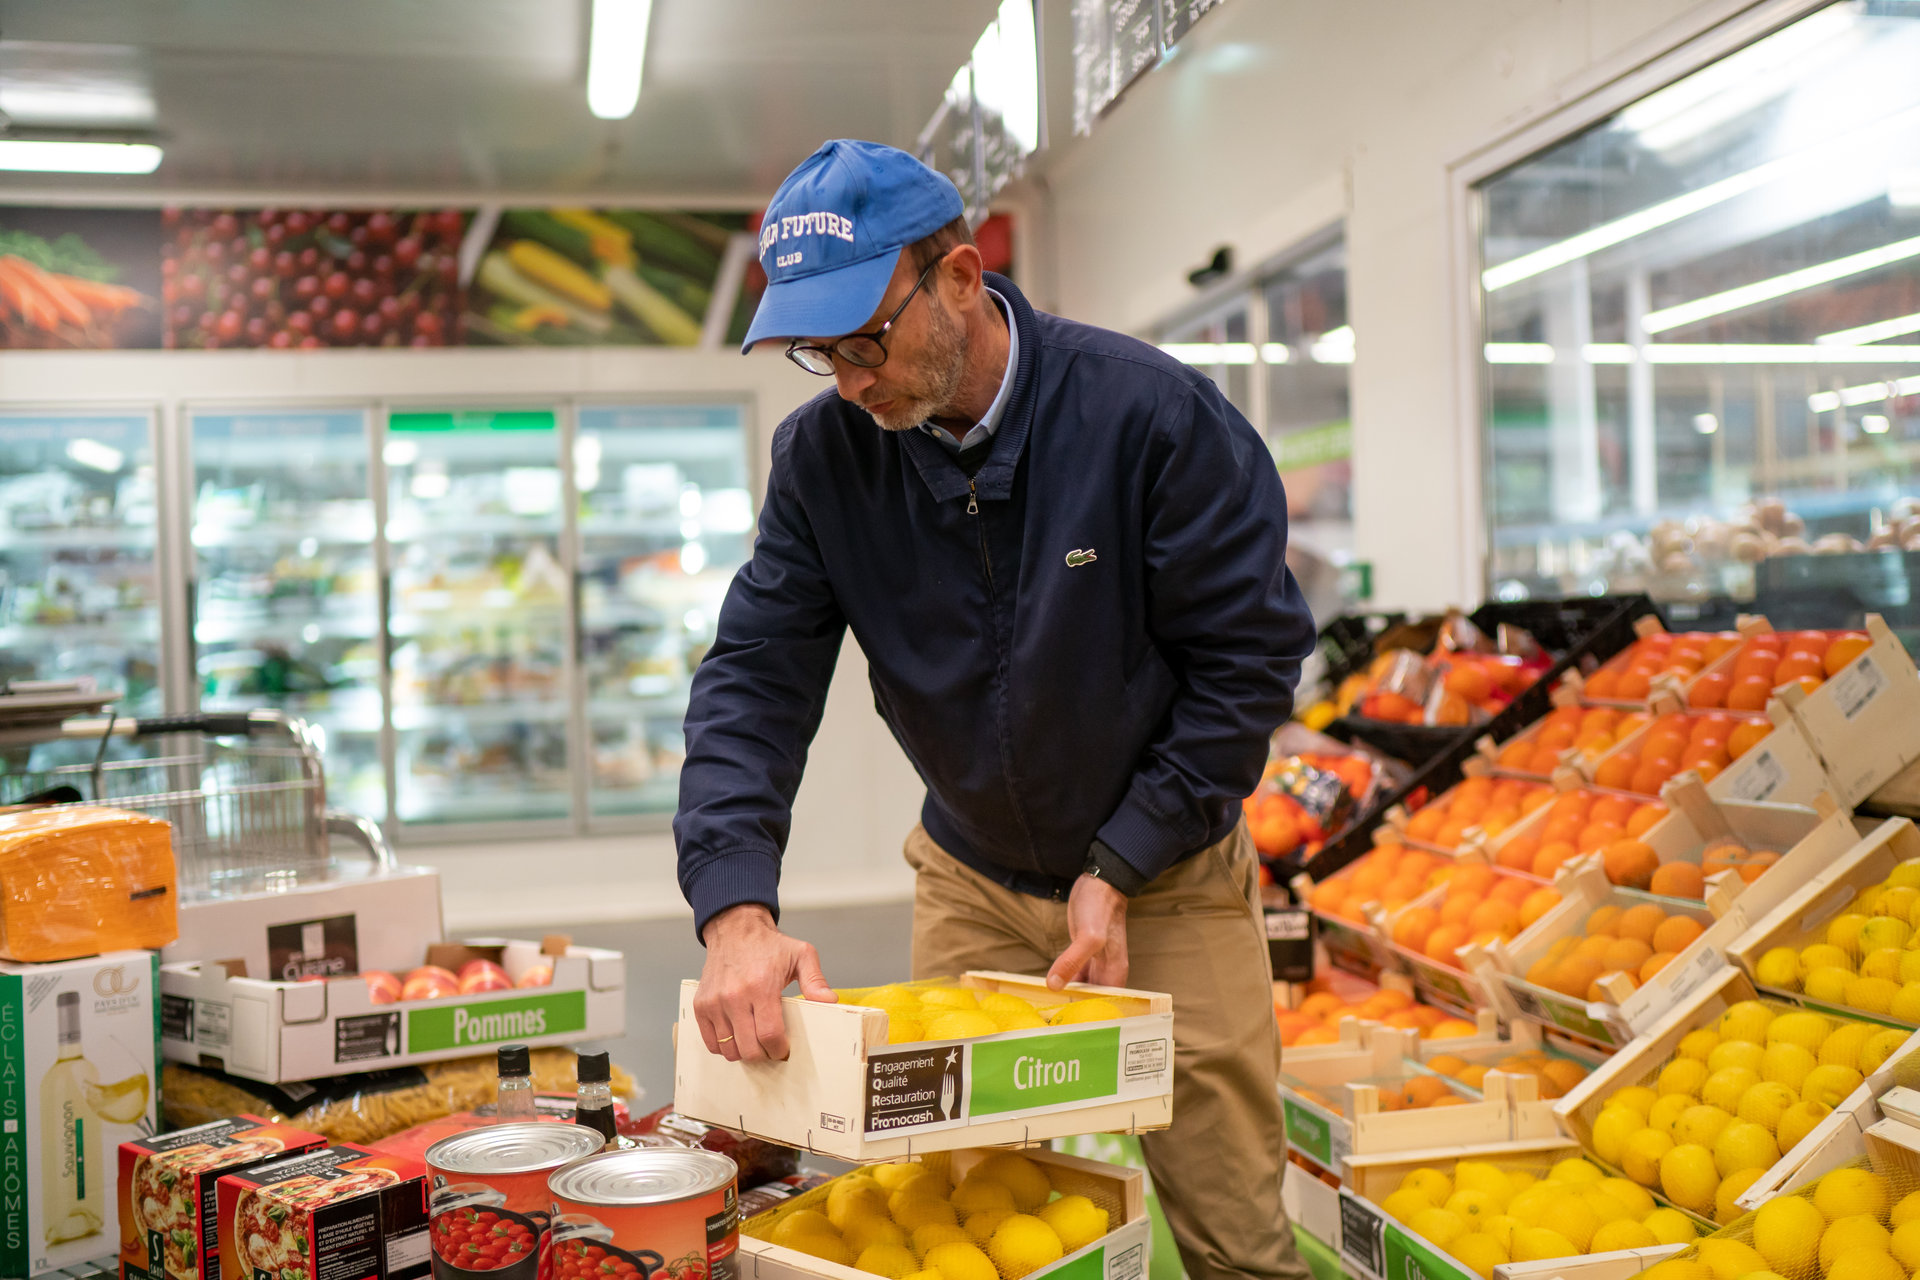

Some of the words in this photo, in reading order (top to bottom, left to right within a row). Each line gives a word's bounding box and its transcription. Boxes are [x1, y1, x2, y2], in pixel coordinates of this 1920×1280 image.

[781, 211, 854, 243] FUTURE
[776, 251, 803, 269] CLUB
[453, 1007, 547, 1044] Pommes
[873, 1056, 935, 1075] Engagement
[1013, 1055, 1081, 1090] Citron
[872, 1074, 909, 1092] Qualité
[872, 1089, 936, 1107] Restauration
[871, 1110, 934, 1131] Promocash
[62, 1101, 76, 1178] Sauvignon
